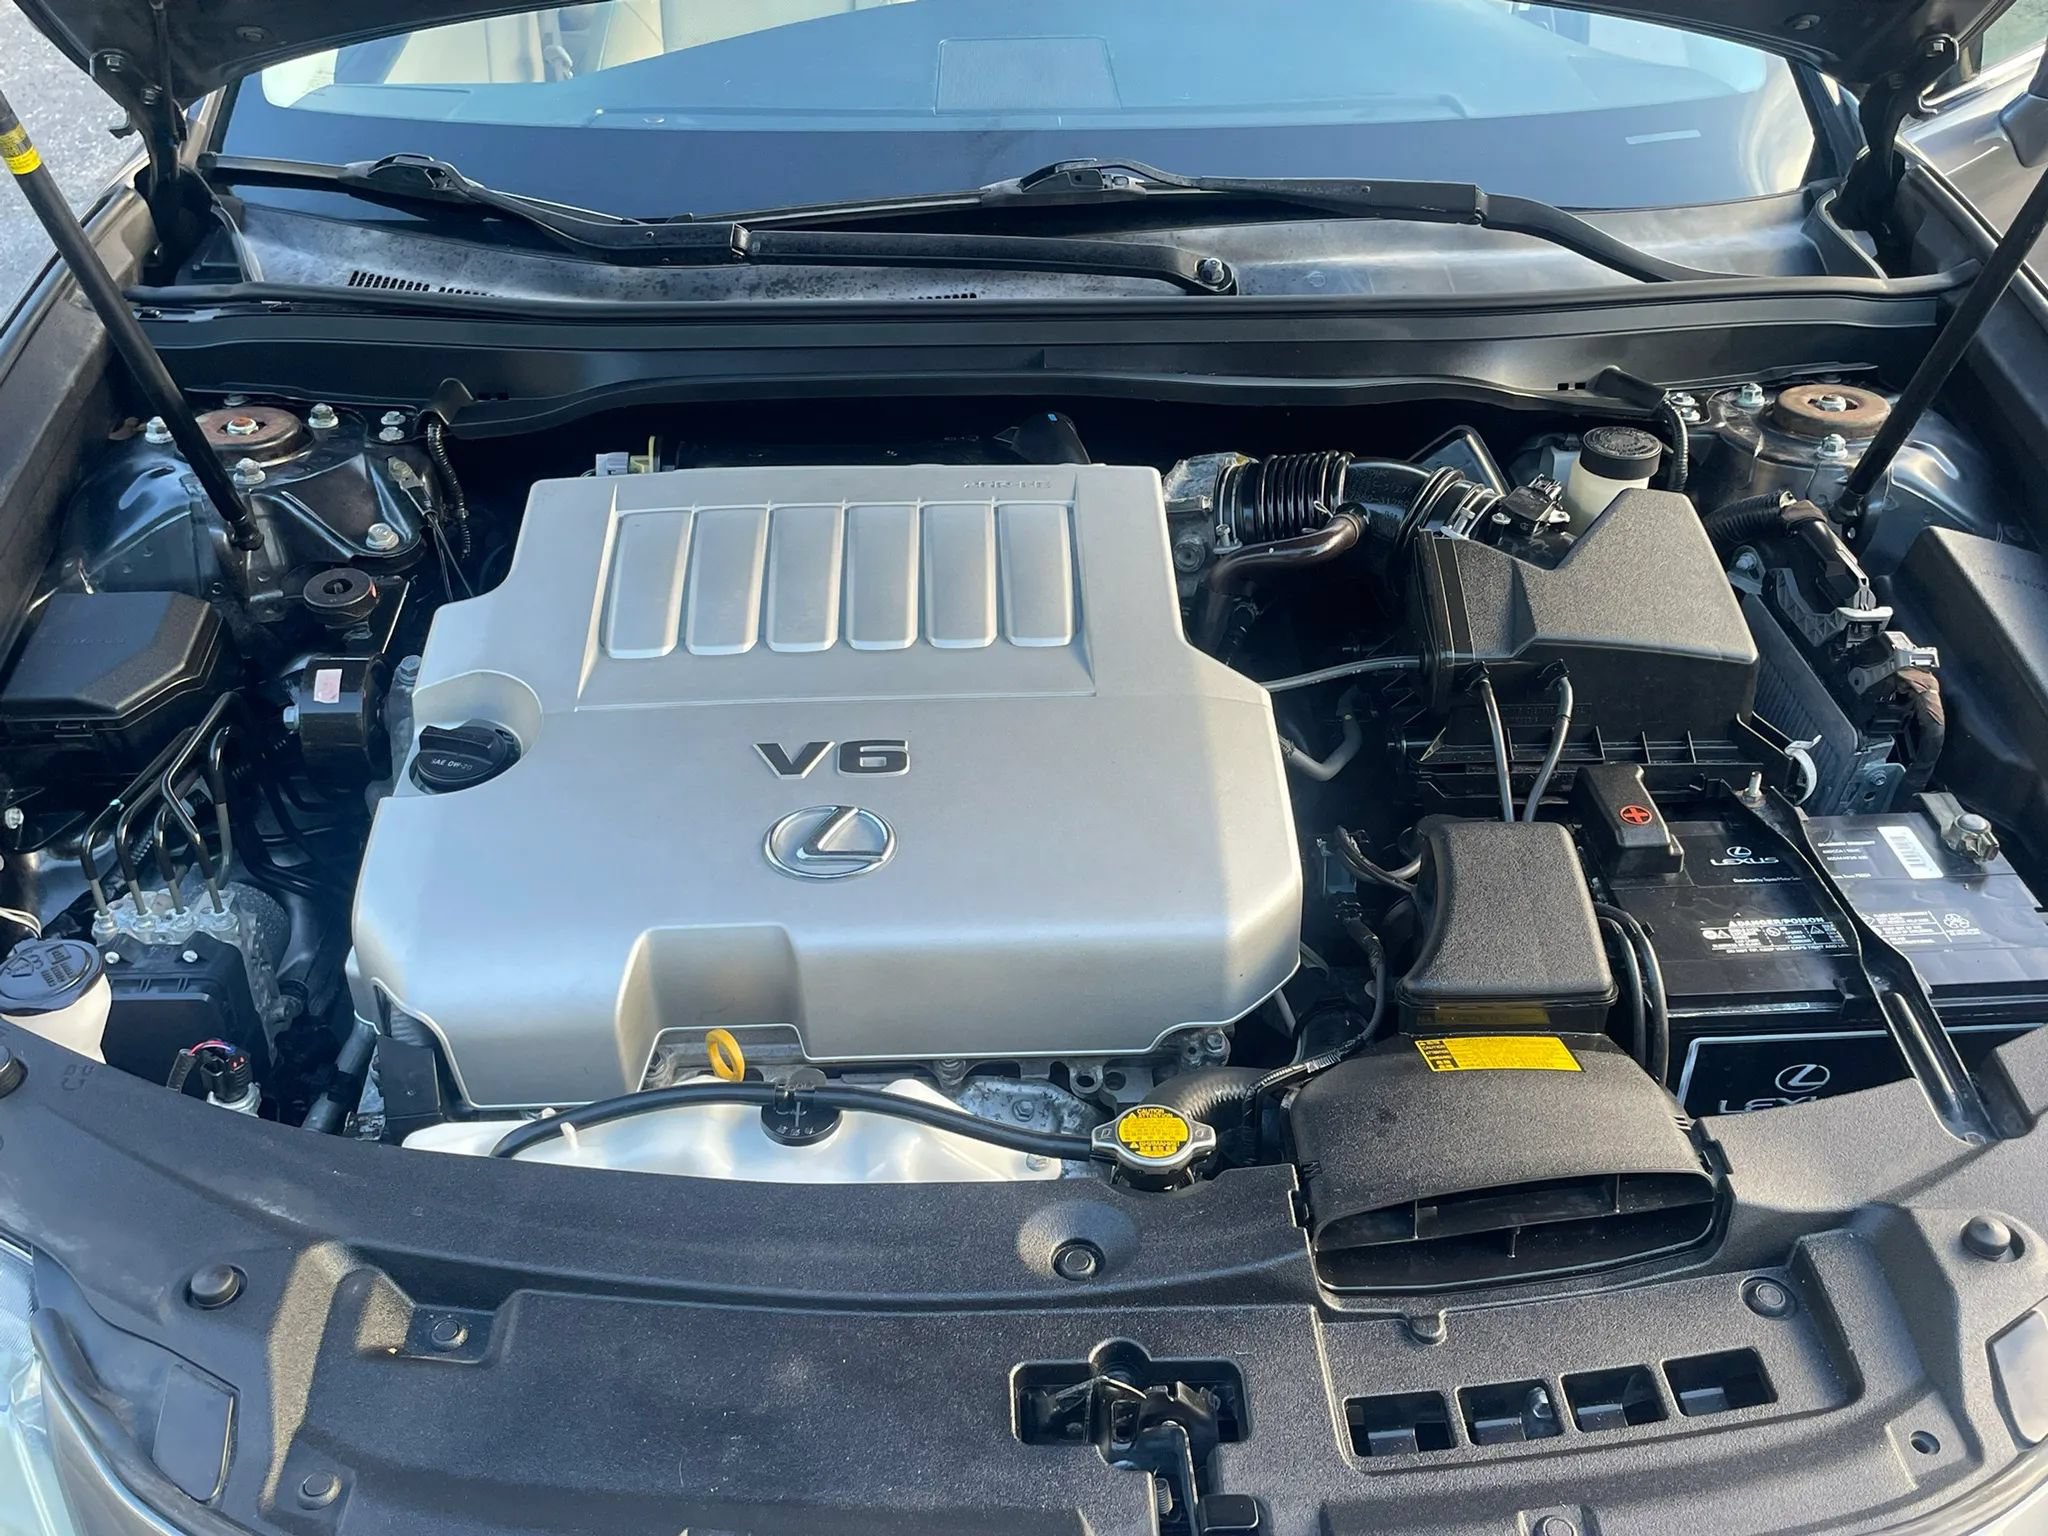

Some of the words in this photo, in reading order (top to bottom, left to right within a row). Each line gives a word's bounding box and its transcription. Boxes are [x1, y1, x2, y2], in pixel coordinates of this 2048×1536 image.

[753, 740, 910, 780] V6
[1709, 857, 1779, 866] LEXUS
[1737, 917, 1825, 927] DANGER/POISON
